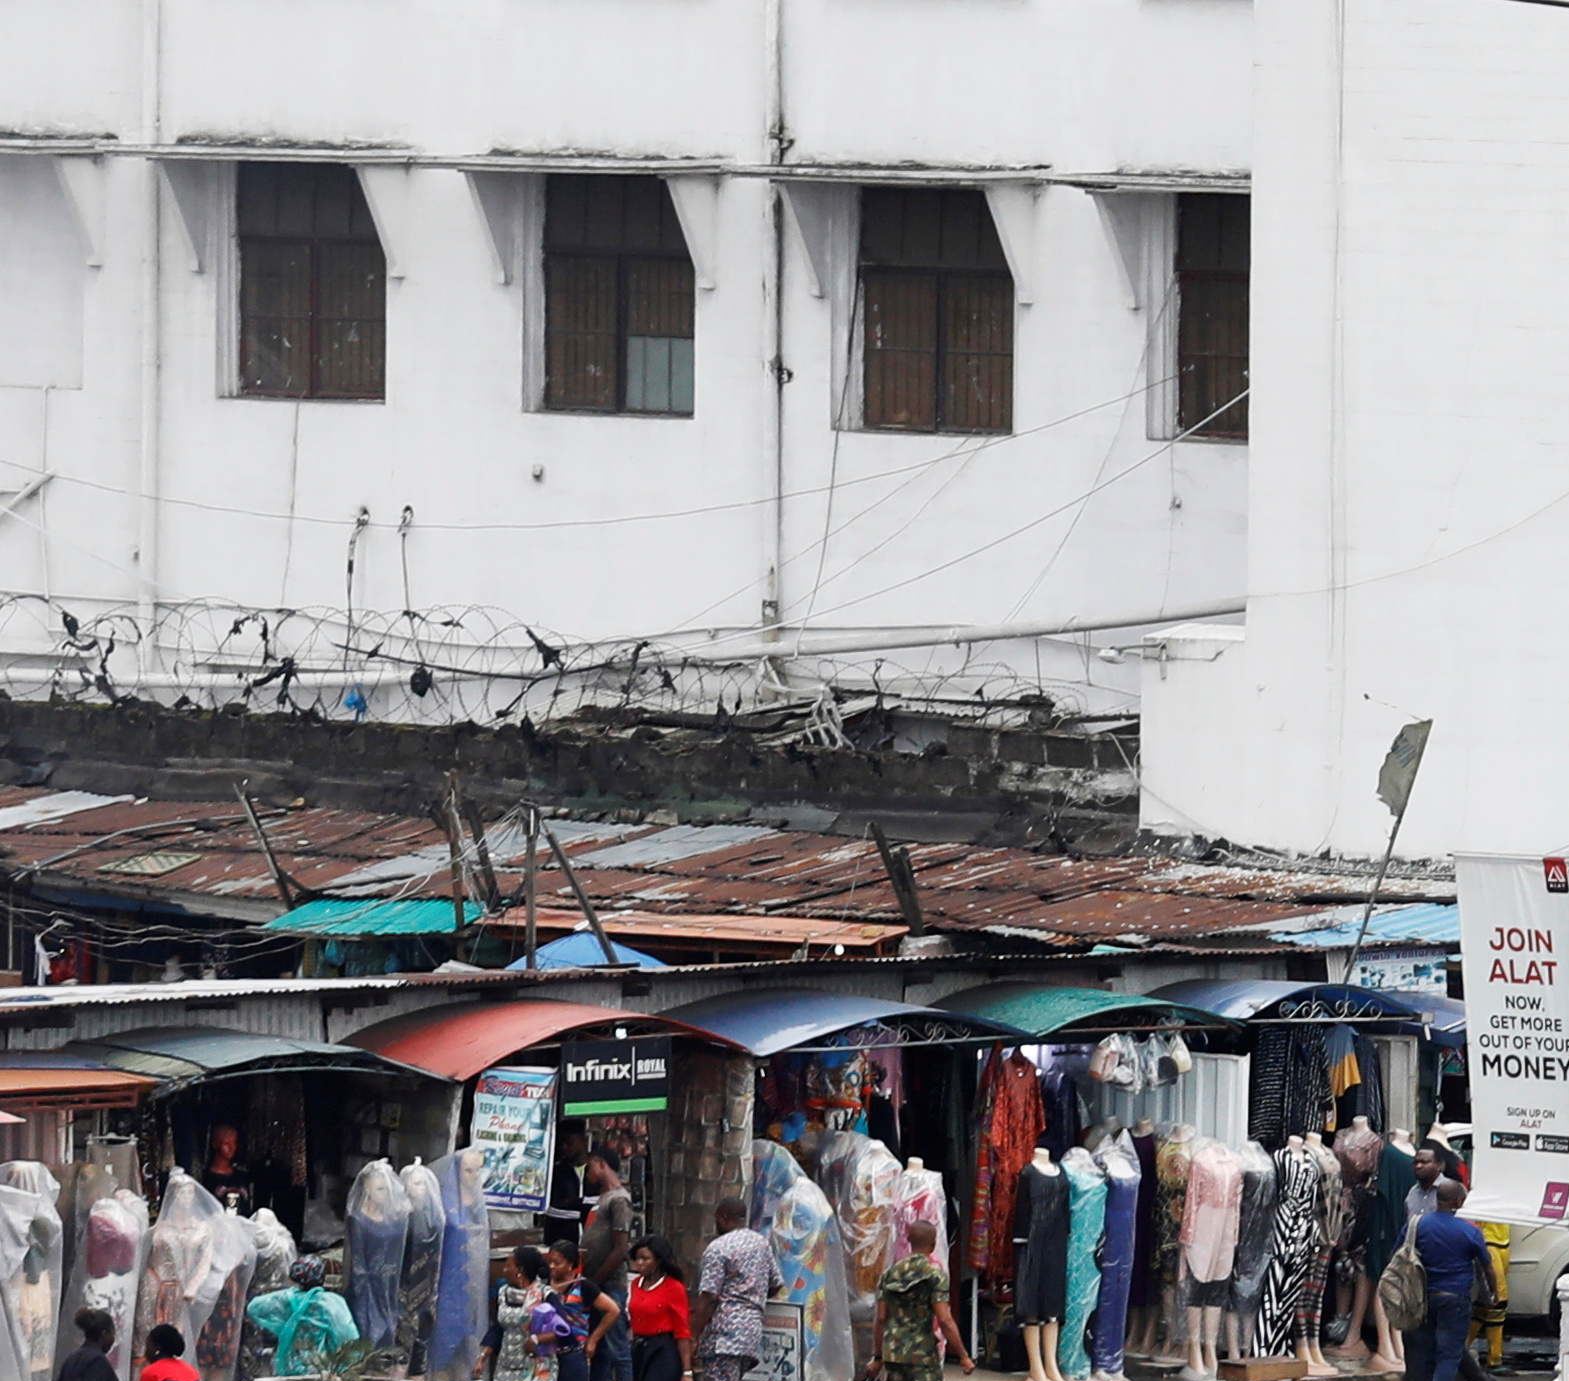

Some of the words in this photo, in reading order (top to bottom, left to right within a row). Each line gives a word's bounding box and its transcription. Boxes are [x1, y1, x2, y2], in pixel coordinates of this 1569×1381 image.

[1489, 927, 1553, 953] JOIN
[1488, 958, 1557, 985] ALAT
[1490, 1015, 1518, 1030] GET
[1521, 1017, 1562, 1032] MORE
[1479, 1034, 1508, 1049] OUT
[1513, 1035, 1532, 1050] OF
[567, 1058, 631, 1082] Infinix
[637, 1059, 666, 1073] ROYAL
[1506, 1107, 1528, 1118] SIGN
[1529, 1108, 1541, 1118] UP
[1542, 1109, 1556, 1119] ON
[1519, 1119, 1542, 1128] ALAT
